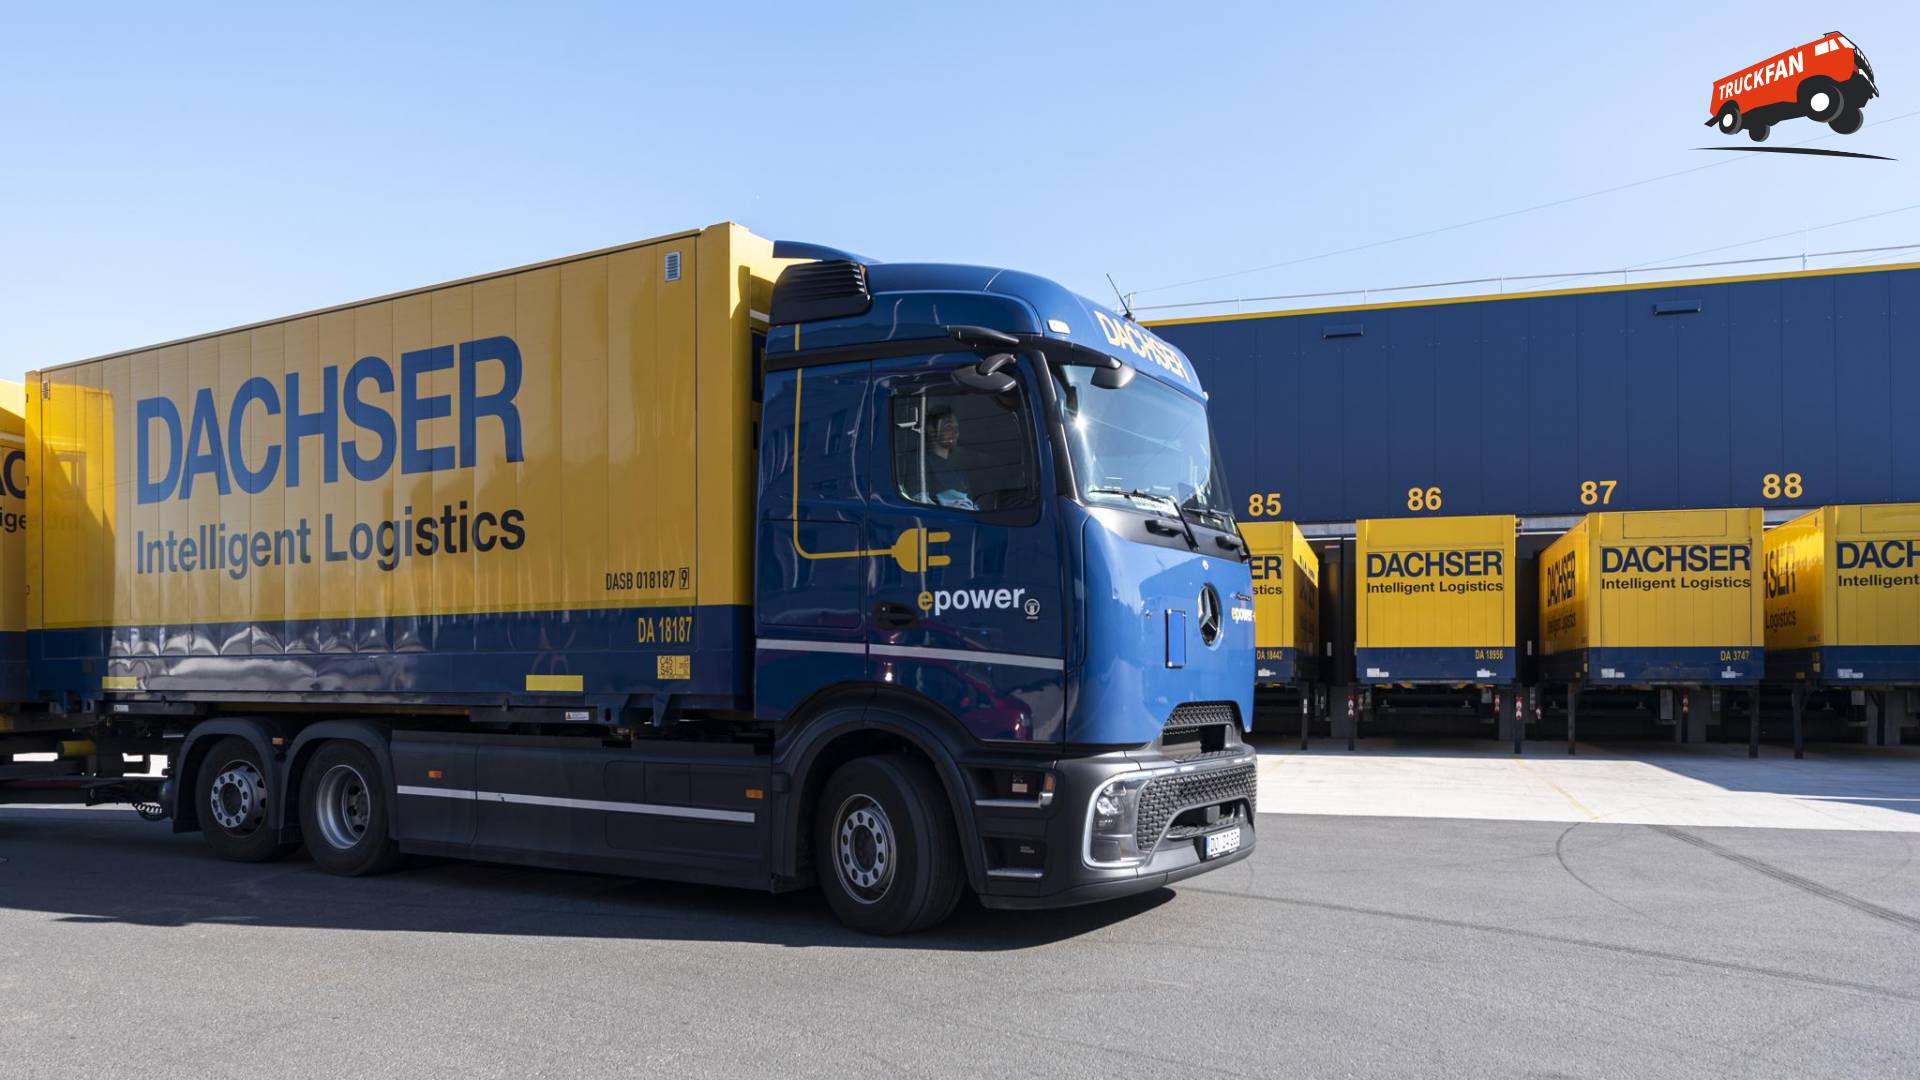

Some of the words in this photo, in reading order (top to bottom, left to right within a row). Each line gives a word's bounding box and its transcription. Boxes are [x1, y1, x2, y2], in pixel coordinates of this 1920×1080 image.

[1094, 310, 1191, 384] DACHSER
[137, 335, 524, 505] DACHSER
[1407, 487, 1442, 511] 86
[1580, 480, 1618, 505] 87
[1762, 472, 1803, 499] 88
[1248, 493, 1282, 516] 85
[136, 518, 311, 580] Intelligent
[325, 500, 526, 572] Logistics
[1367, 550, 1503, 578] DACHSER
[1601, 544, 1751, 573] DACHSER
[606, 573, 633, 591] DASB
[637, 570, 675, 589] 018187
[1367, 581, 1435, 595] Intelligent
[1439, 580, 1504, 594] Logistics
[1601, 578, 1676, 591] Intelligent
[1681, 576, 1752, 591] Logistics
[1838, 574, 1920, 589] Intelligent
[917, 588, 1026, 616] epower
[638, 617, 655, 643] DA
[659, 616, 693, 643] 18187
